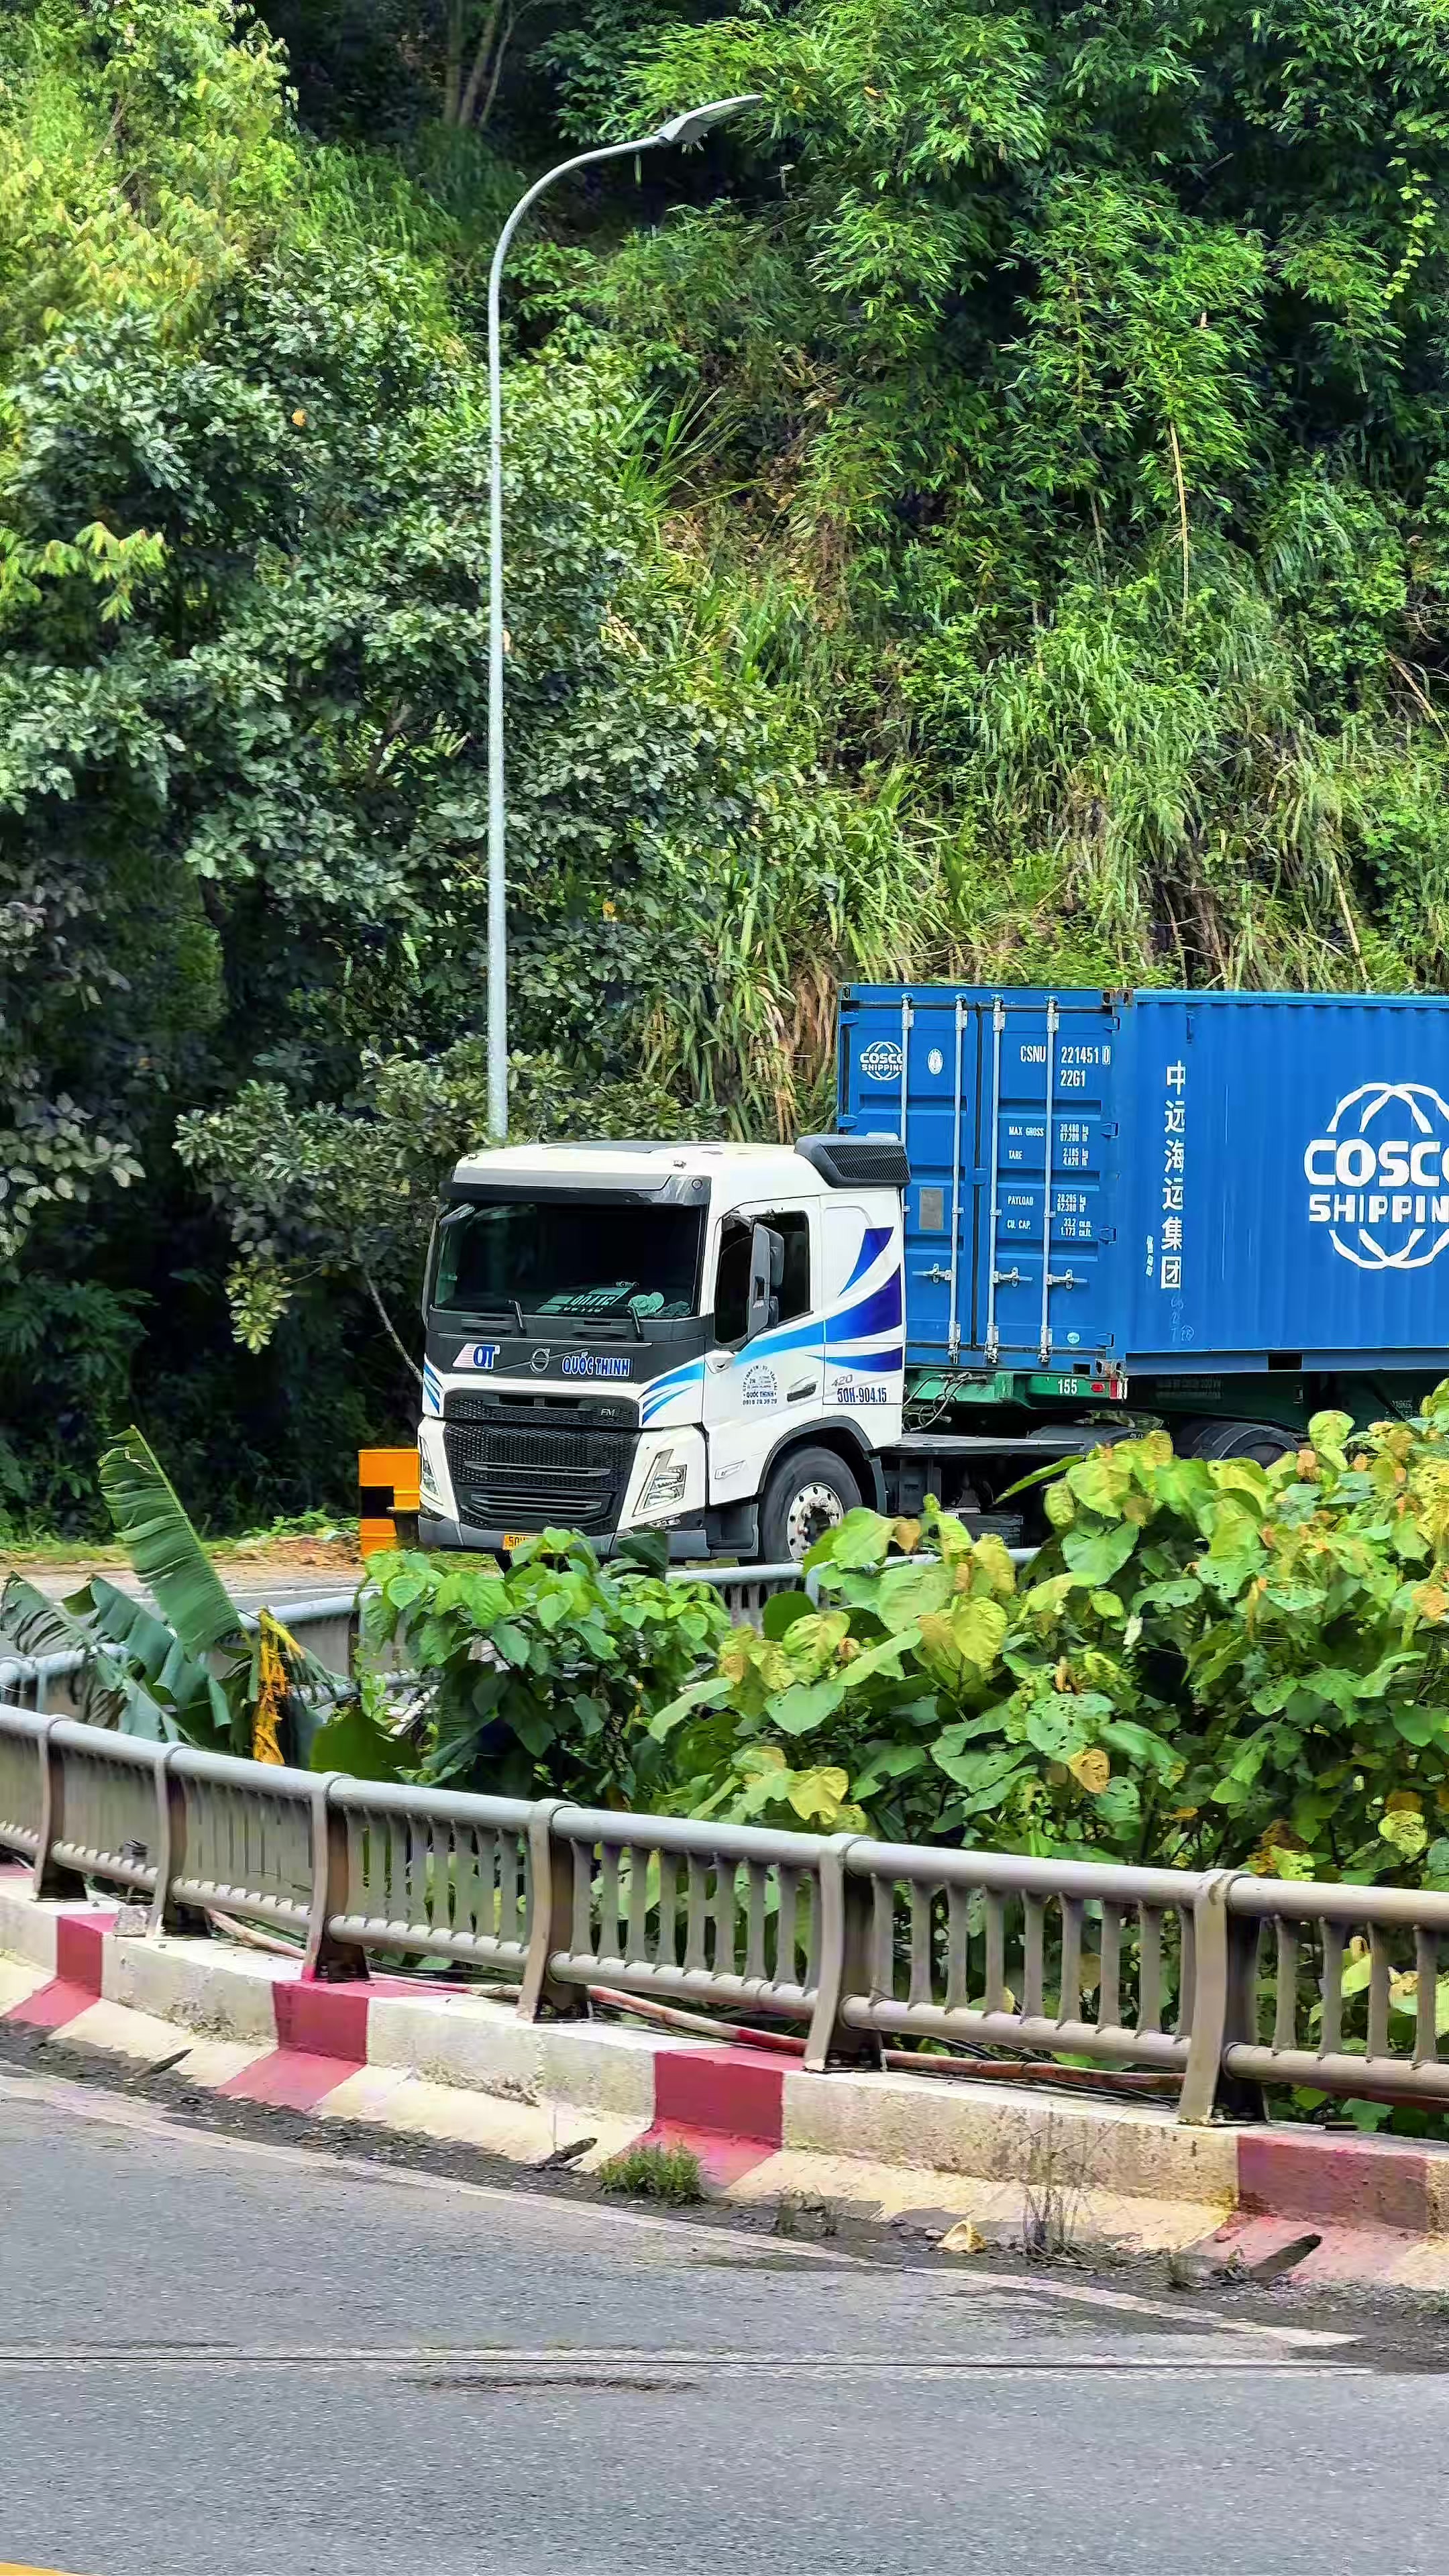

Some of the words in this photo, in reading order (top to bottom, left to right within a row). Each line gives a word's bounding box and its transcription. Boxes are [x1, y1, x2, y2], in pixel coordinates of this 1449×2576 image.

[1020, 1045, 1046, 1063] CSNU
[1061, 1046, 1099, 1063] 221451
[1060, 1069, 1085, 1087] 22G1
[1009, 1126, 1022, 1135] MAX
[1026, 1127, 1044, 1136] GROSS
[1009, 1150, 1023, 1160] TARE
[1304, 1138, 1449, 1187] COSC
[1161, 1060, 1186, 1289] 中远海运集团
[1008, 1195, 1034, 1205] PAYLOAD
[562, 1352, 594, 1375] QUỐC
[837, 1387, 887, 1402] 50H-904.15
[1058, 1379, 1077, 1395] 155
